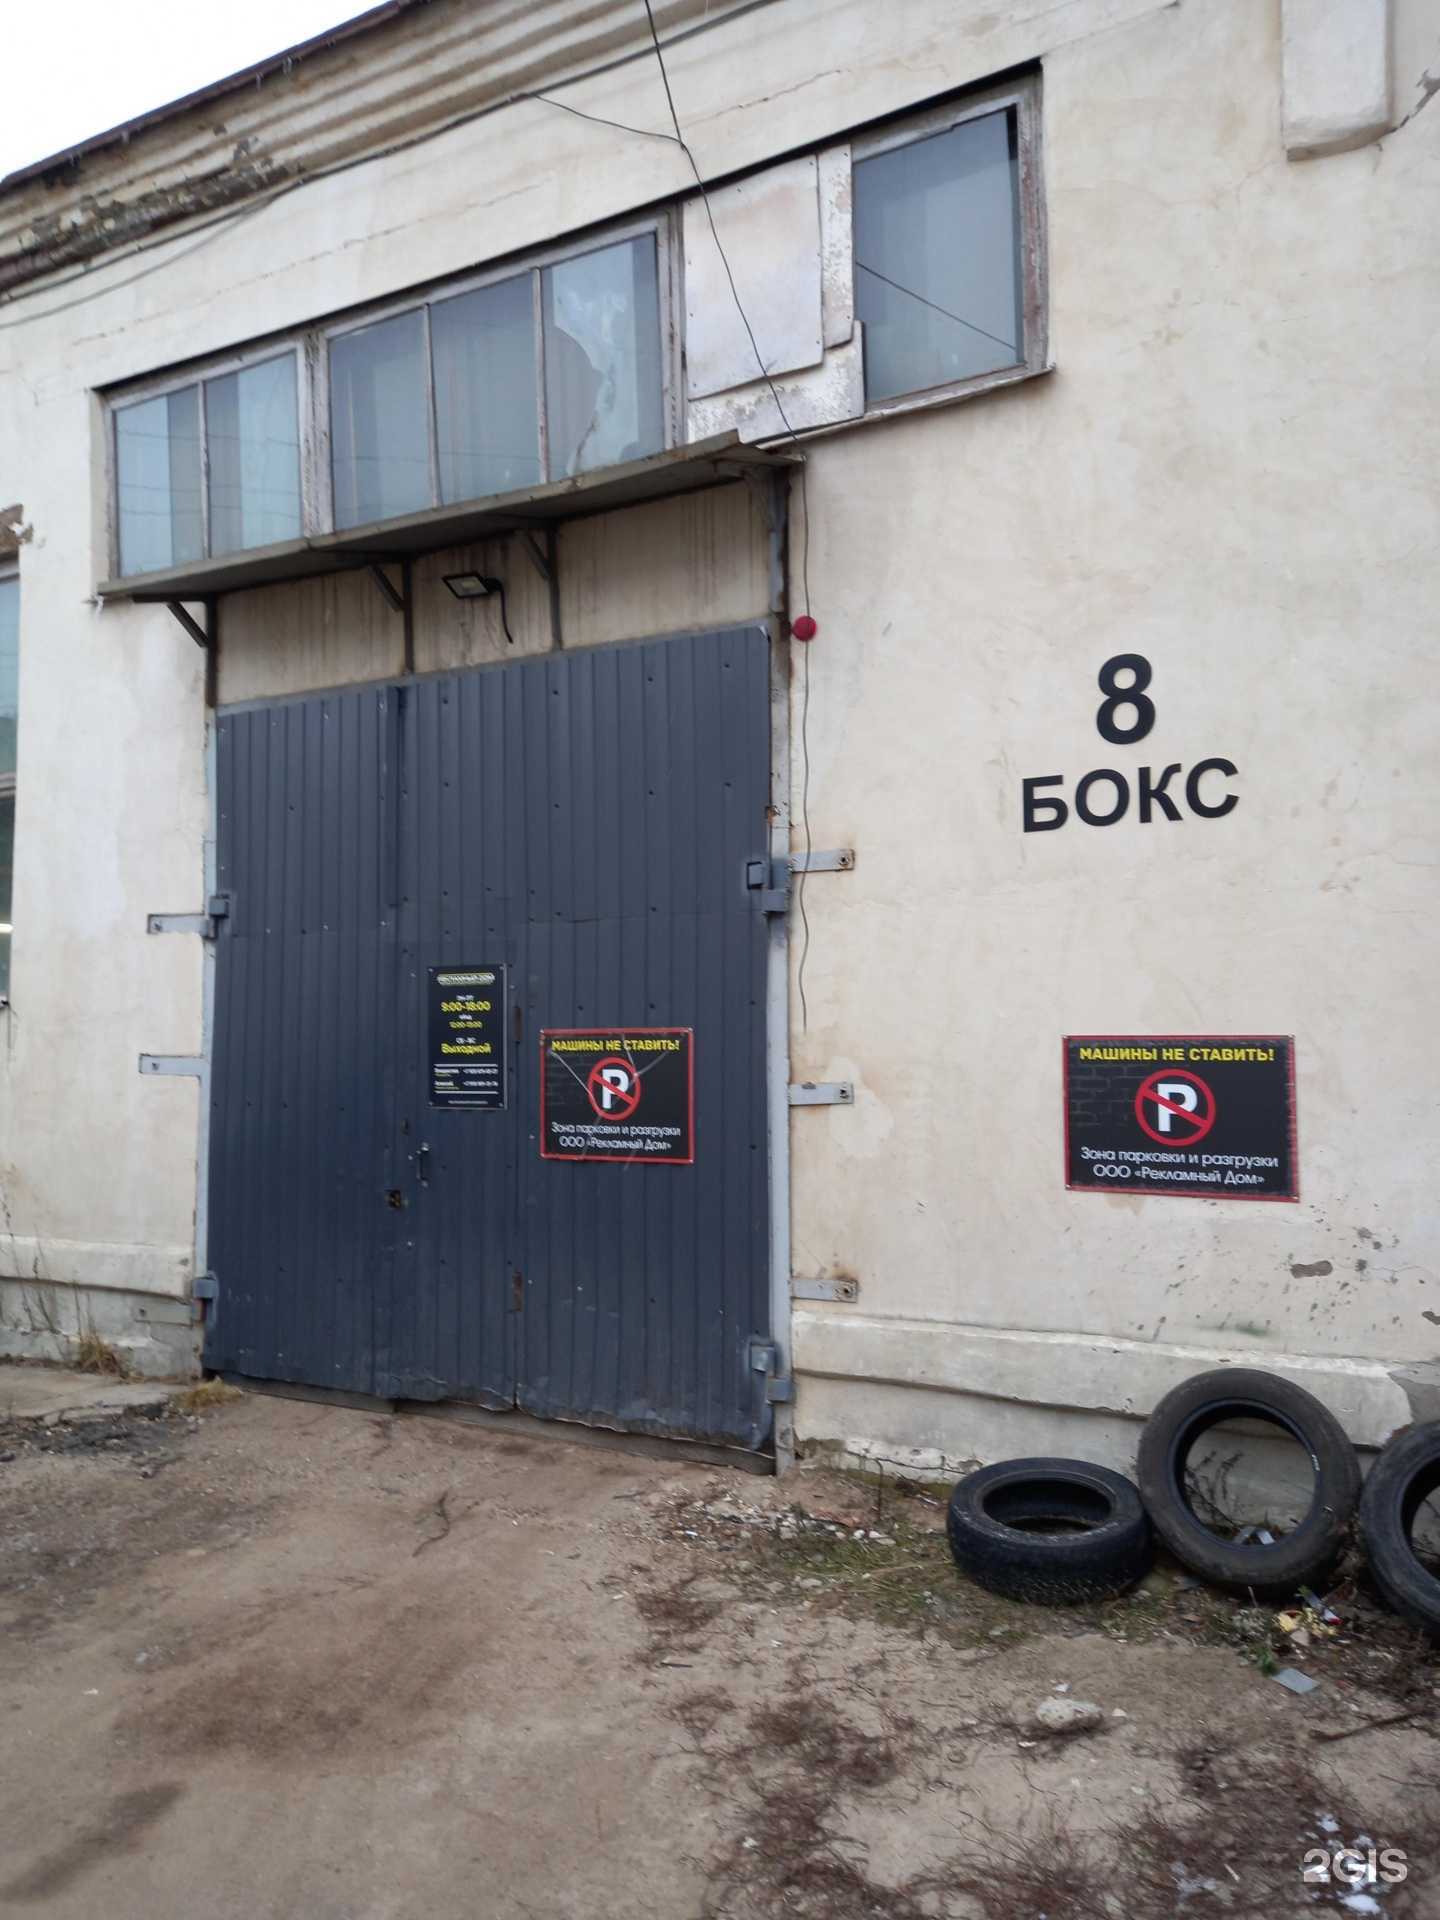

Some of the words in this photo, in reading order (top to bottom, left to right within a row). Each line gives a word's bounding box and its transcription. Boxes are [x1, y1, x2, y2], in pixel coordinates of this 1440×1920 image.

[1096, 653, 1156, 745] 8
[1021, 757, 1240, 833] БОКС
[551, 1040, 603, 1051] МАШИНЫ
[605, 1040, 622, 1051] НЕ
[623, 1039, 680, 1051] СТАВИТЬ!
[1079, 1047, 1158, 1061] МАШИНЫ
[1162, 1047, 1186, 1061] НЕ
[1188, 1047, 1275, 1062] СТАВИТЬ!
[551, 1121, 575, 1134] Зона
[576, 1123, 620, 1137] парковки
[621, 1125, 629, 1135] и
[630, 1125, 681, 1138] разгрузки
[558, 1136, 585, 1149] ООО
[1080, 1146, 1116, 1161] Зона
[1118, 1150, 1185, 1167] парковки
[1188, 1154, 1198, 1165] и
[1201, 1153, 1279, 1170] разгрузки
[1092, 1164, 1131, 1179] ООО
[1134, 1166, 1221, 1184] «Рекламный
[1223, 1170, 1265, 1186] Дом»
